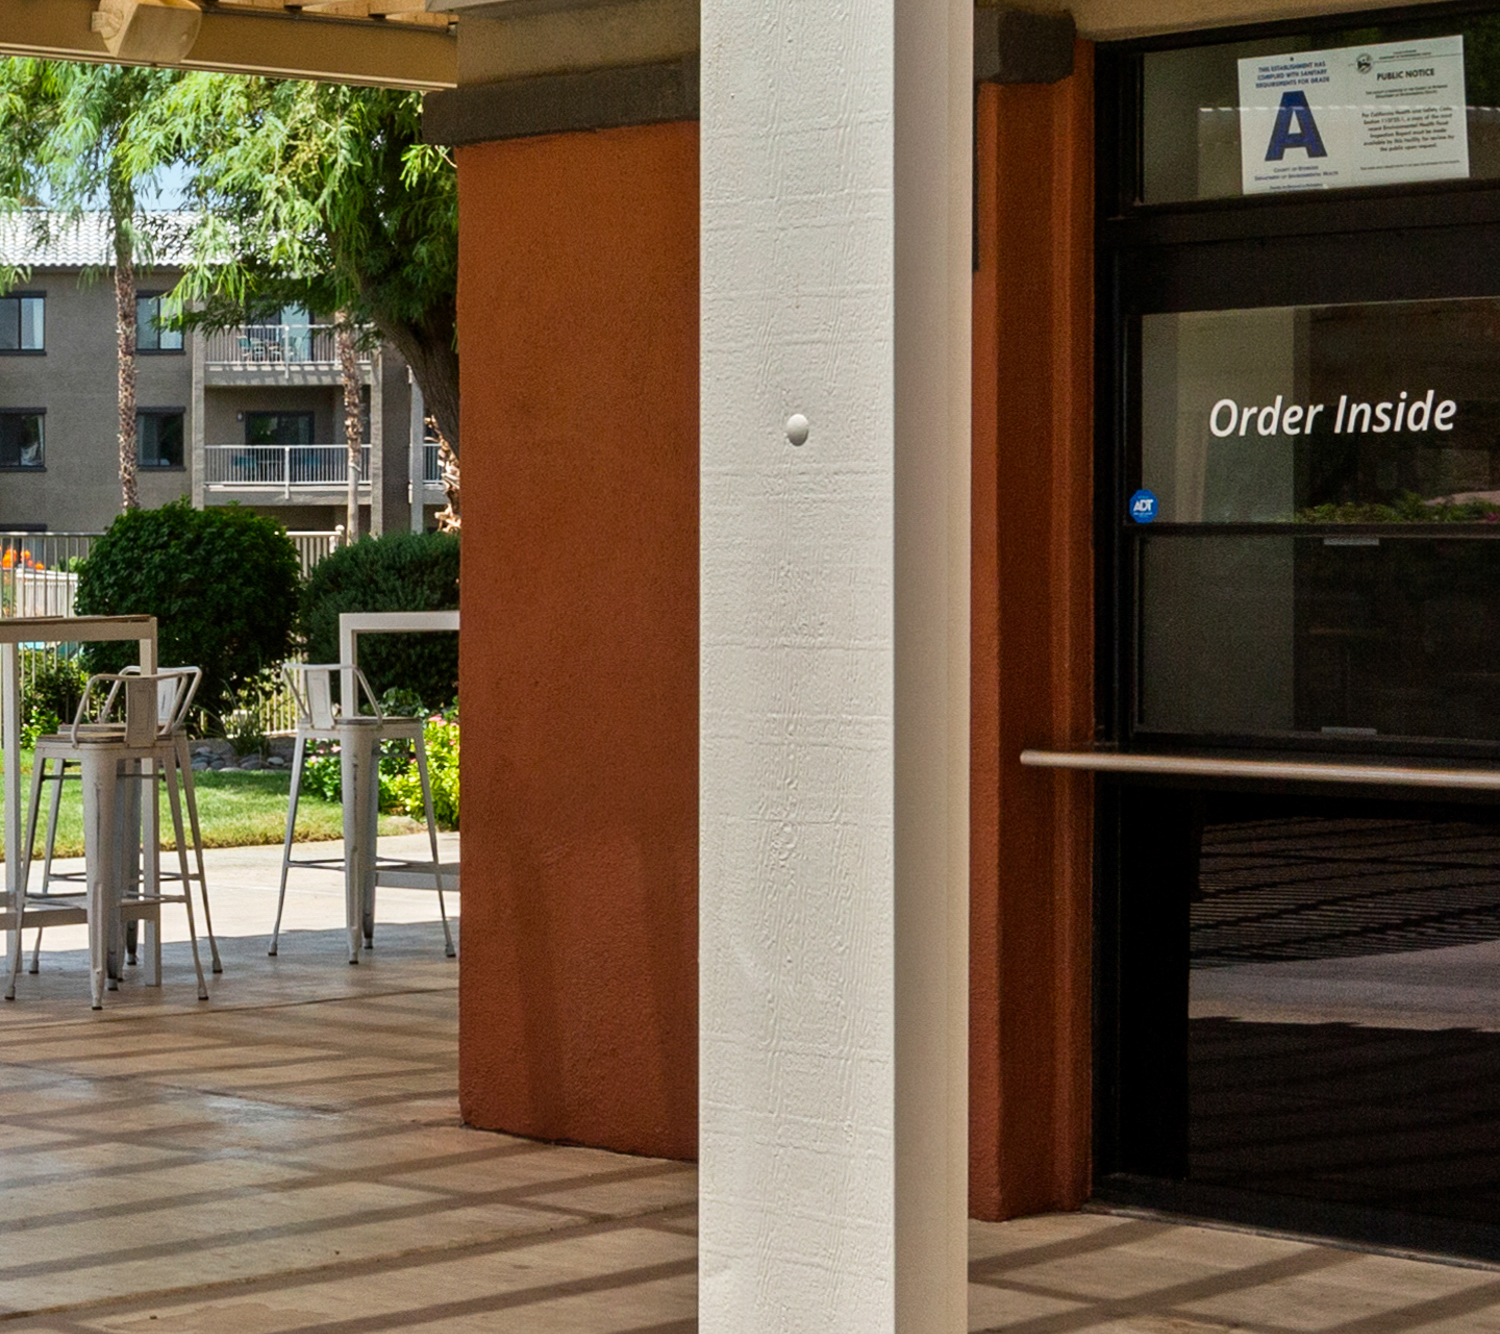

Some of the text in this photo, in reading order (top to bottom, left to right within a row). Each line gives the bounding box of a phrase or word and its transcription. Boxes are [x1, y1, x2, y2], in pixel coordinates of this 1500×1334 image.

[1377, 68, 1435, 81] PUBLIC NOTICE
[1264, 90, 1328, 162] A
[1210, 390, 1456, 437] Order Inside
[1133, 499, 1154, 512] ADT
